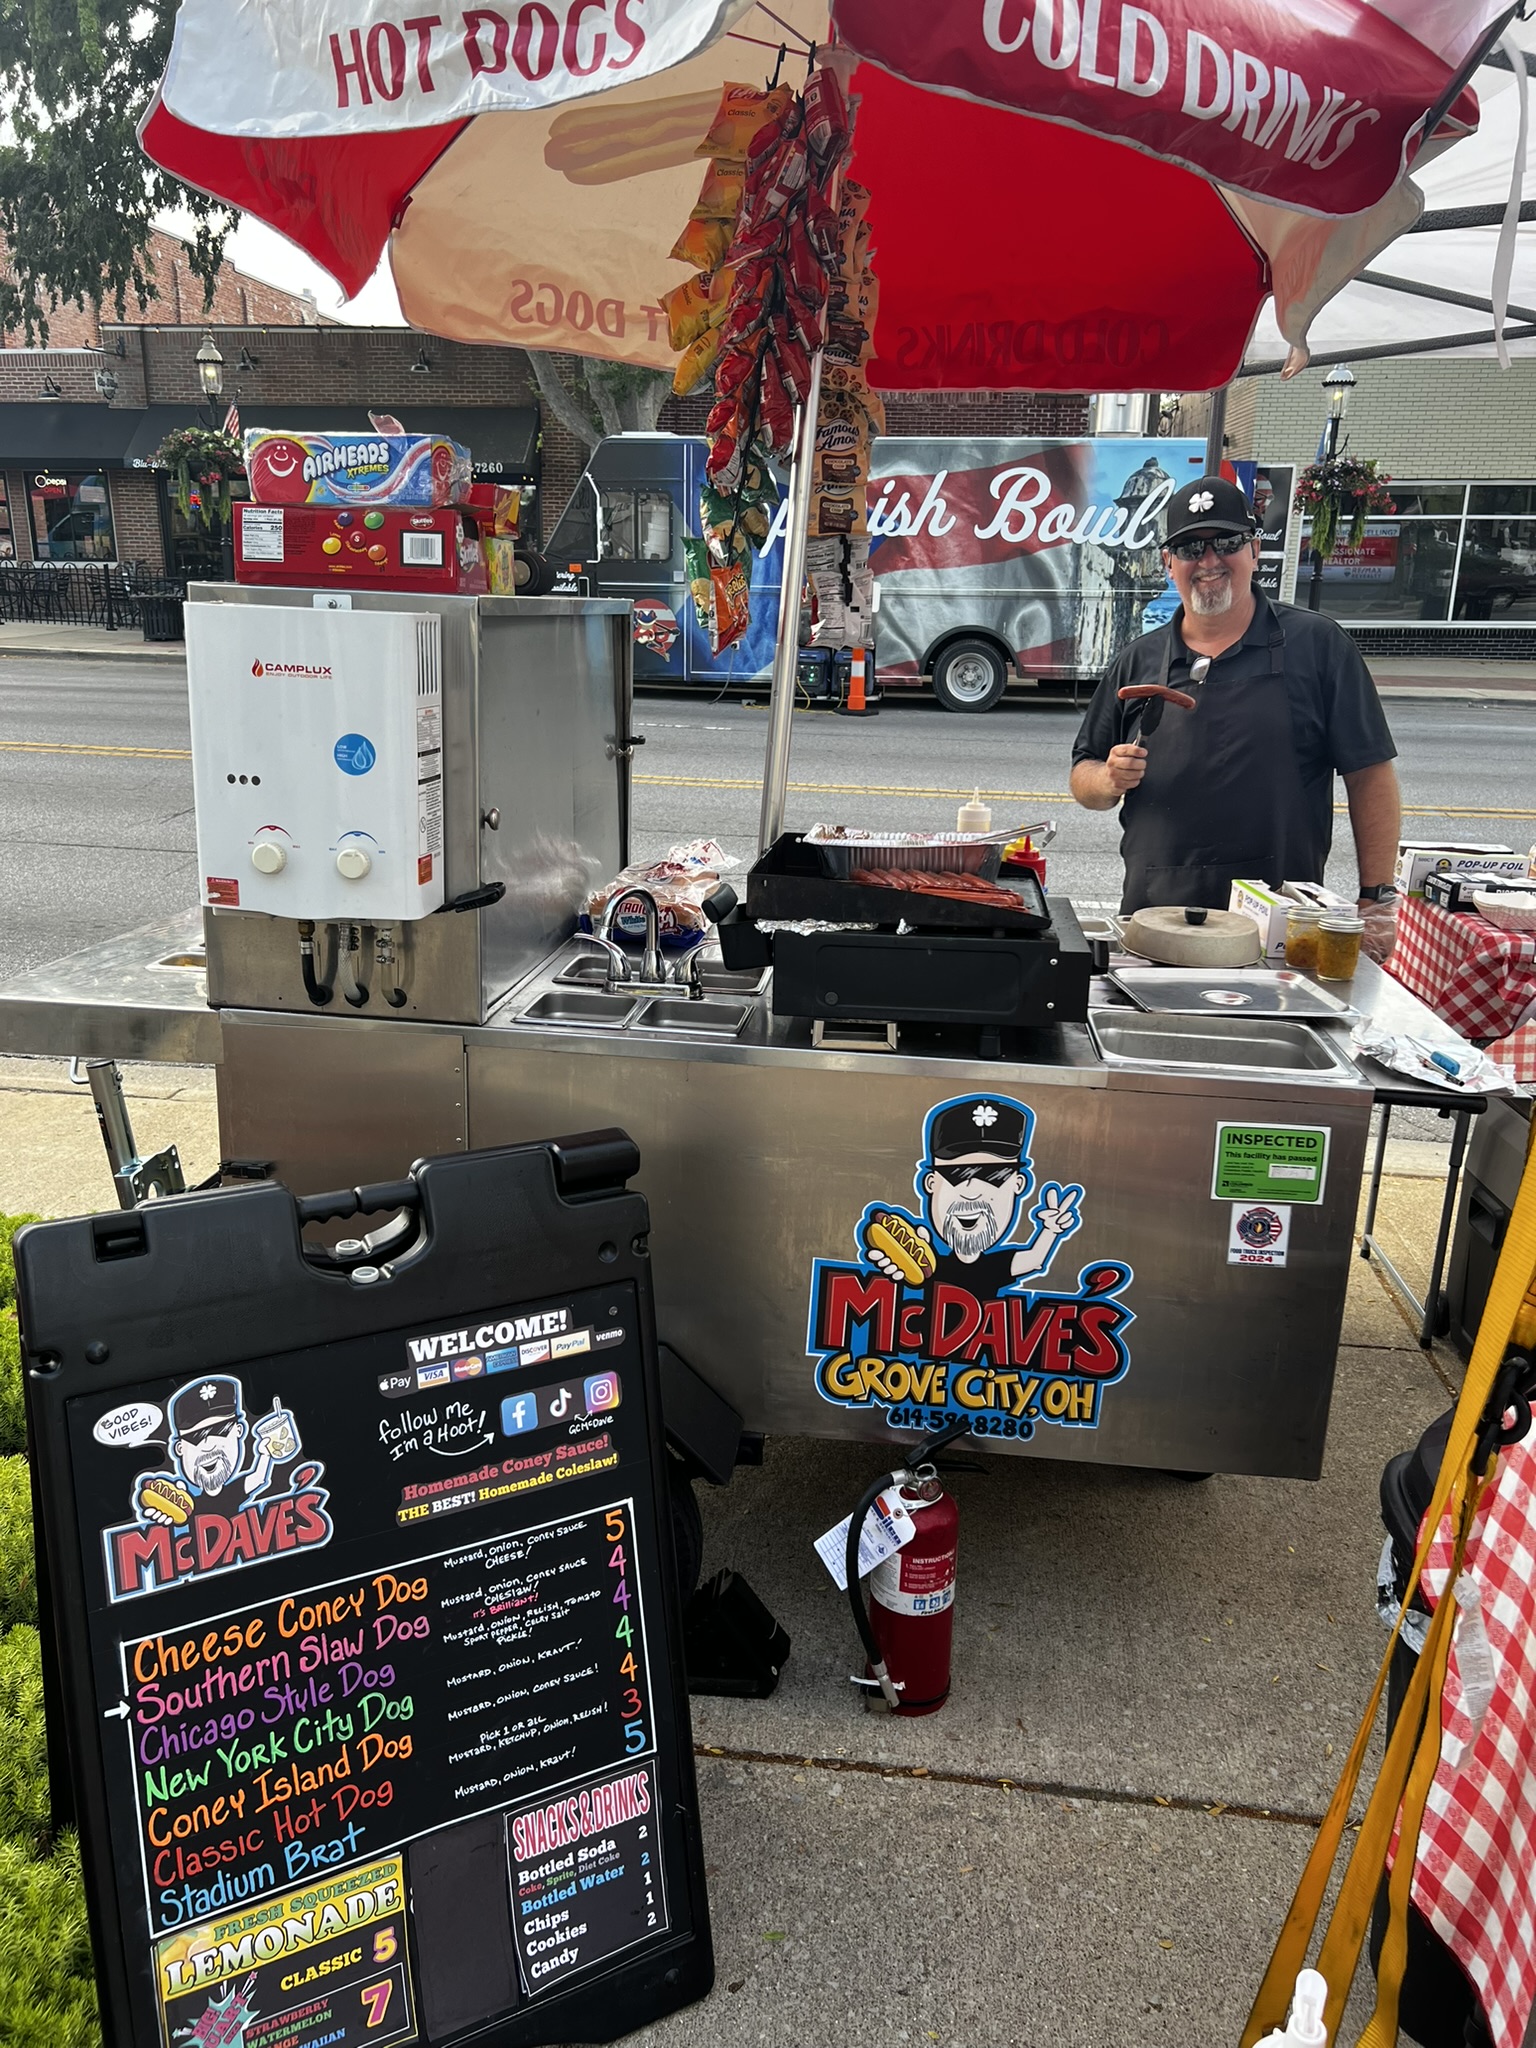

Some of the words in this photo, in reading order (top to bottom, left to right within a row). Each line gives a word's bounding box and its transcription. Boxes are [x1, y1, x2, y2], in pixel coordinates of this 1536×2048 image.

[328, 16, 447, 108] HOT
[463, 0, 646, 80] DOGS
[982, 0, 1168, 98] COLD
[1181, 30, 1380, 170] DRINKS
[727, 108, 756, 118] Classic
[716, 168, 744, 177] Classic
[815, 435, 856, 451] Amos
[817, 424, 860, 440] Famous
[46, 478, 67, 487] pepsi
[303, 442, 390, 482] AIRHEADS
[347, 464, 389, 479] XTREMES
[475, 462, 503, 474] 7260
[975, 467, 1176, 550] Bowl
[265, 663, 332, 675] CAMPLUX
[1457, 860, 1498, 870] POP-UP
[1500, 862, 1524, 871] FOIL
[1225, 1151, 1241, 1159] This
[1243, 1152, 1271, 1161] facility
[1288, 1154, 1317, 1163] passed
[1226, 1133, 1318, 1149] INSPECTED
[1239, 1255, 1273, 1263] 2024
[390, 1375, 411, 1389] Pay
[424, 1369, 444, 1380] VISA
[521, 1344, 548, 1355] DISCOVER
[555, 1338, 585, 1351] PayPal
[595, 1329, 623, 1342] venmo
[408, 1310, 568, 1362] WELCOME!
[827, 1353, 946, 1402] GROVE
[1042, 1379, 1096, 1419] OH
[100, 1408, 139, 1430] GOOD
[108, 1415, 153, 1440] VIBES!
[389, 1436, 418, 1461] I'm
[423, 1430, 433, 1446] a
[437, 1410, 487, 1443] Hoot!
[398, 1504, 430, 1522] THE
[432, 1491, 477, 1514] BEST!
[479, 1472, 553, 1501] Homemade
[555, 1453, 618, 1480] Coleslaw!
[404, 1465, 498, 1501] Homemade
[502, 1452, 553, 1476] Coney
[555, 1434, 609, 1461] Sauce!
[605, 1508, 625, 1542] 5
[607, 1544, 627, 1577] 4
[612, 1579, 632, 1611] 4
[134, 1618, 267, 1683] Cheese
[277, 1587, 365, 1638] Coney
[372, 1574, 429, 1612] Dog
[615, 1614, 634, 1648] 4
[136, 1651, 291, 1725] Southern
[299, 1628, 364, 1674] Slaw
[372, 1614, 431, 1651] Dog
[619, 1651, 638, 1682] 4
[139, 1708, 255, 1765] Chicago
[261, 1676, 334, 1723] Style
[337, 1661, 396, 1698] Dog
[620, 1688, 643, 1719] 3
[145, 1760, 211, 1806] New
[216, 1731, 288, 1778] York
[293, 1709, 354, 1755] City
[357, 1692, 414, 1733] Dog
[623, 1719, 646, 1754] 5
[148, 1788, 246, 1846] Coney
[253, 1744, 351, 1814] Island
[356, 1733, 413, 1773] Dog
[152, 1829, 264, 1887] Classic
[273, 1798, 326, 1843] Hot
[331, 1780, 394, 1821] Dog
[518, 1853, 574, 1886] Bottled
[577, 1838, 617, 1862] Soda
[638, 1825, 648, 1840] 2
[160, 1863, 274, 1926] Stadium
[283, 1821, 366, 1879] Brat
[519, 1882, 546, 1897] Coke,
[546, 1869, 577, 1887] Sprite,
[578, 1861, 597, 1874] Diet
[598, 1851, 621, 1866] Coke
[521, 1883, 577, 1916] Bottled
[579, 1864, 625, 1892] Water
[640, 1852, 650, 1866] 2
[213, 1903, 284, 1941] FRESH
[290, 1862, 397, 1913] SQUEEZED
[523, 1909, 570, 1936] Chips
[643, 1871, 652, 1886] 1
[526, 1922, 588, 1957] Cookies
[645, 1891, 654, 1905] 1
[164, 1880, 401, 1996] LEMONADE
[280, 1947, 363, 1992] CLASSIC
[372, 1926, 398, 1963] 5
[531, 1948, 579, 1979] Candy
[647, 1912, 657, 1926] 2
[245, 1999, 330, 2040] STRAWBERRY
[361, 1978, 393, 2028] 7
[246, 2009, 333, 2048] WATERMELON
